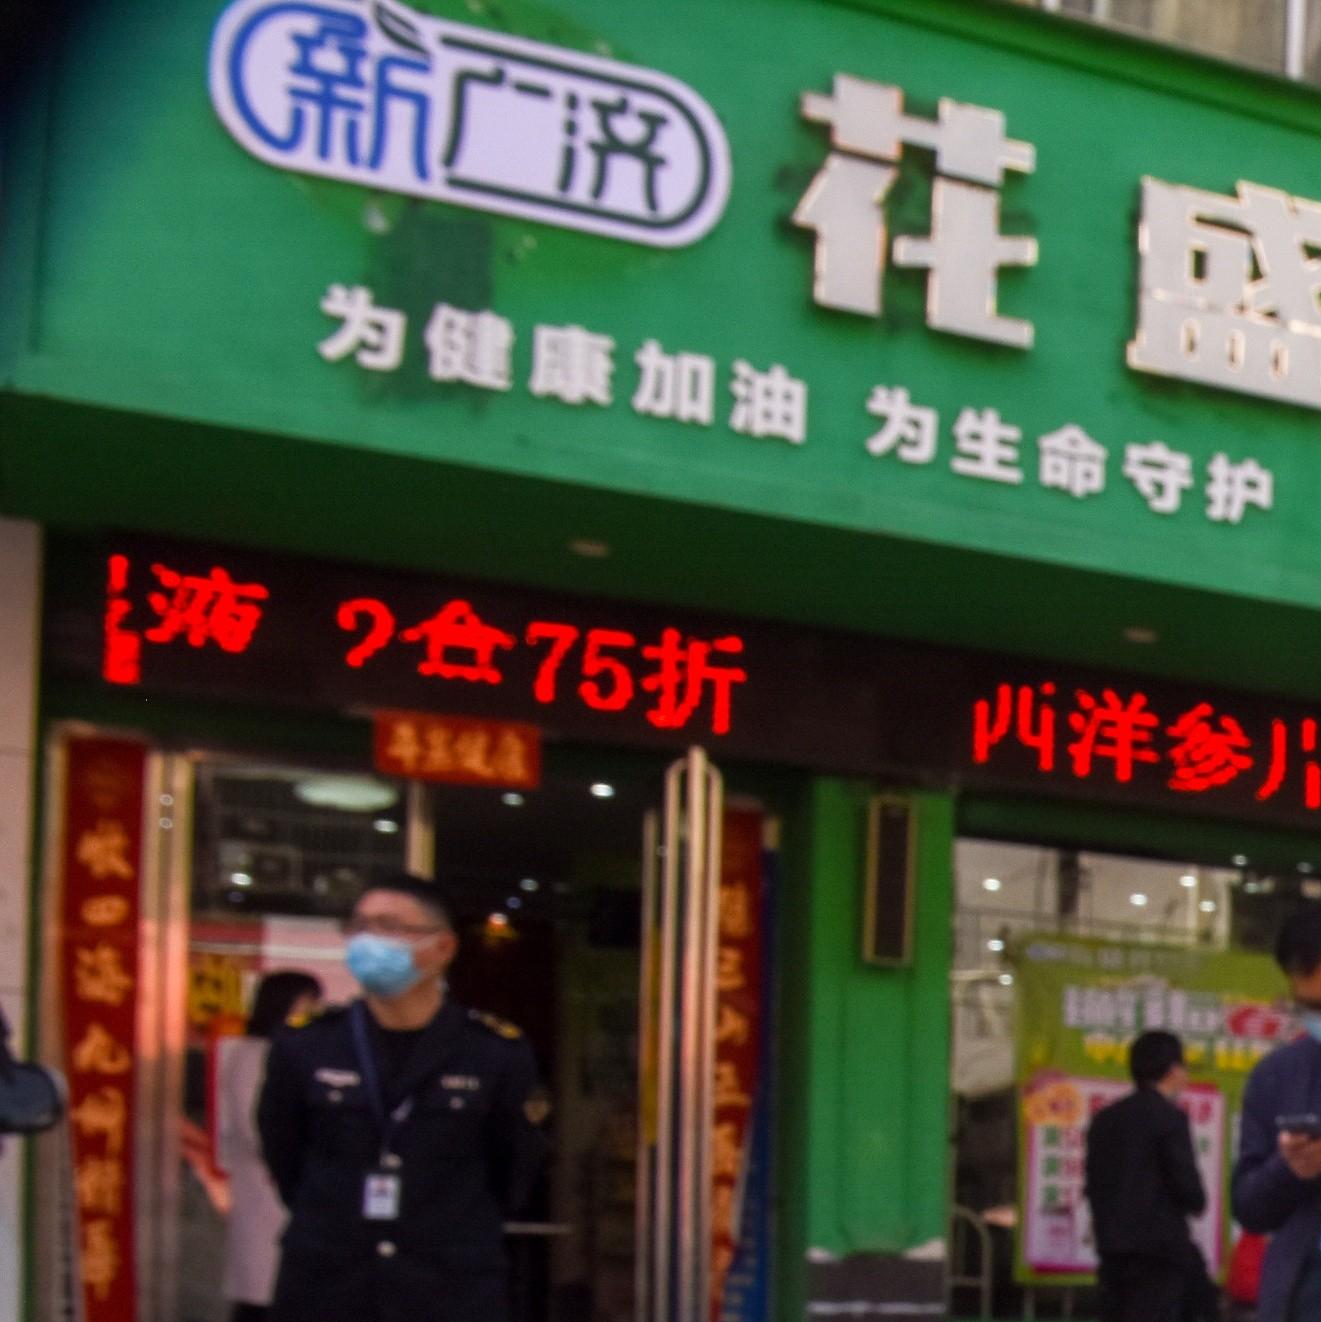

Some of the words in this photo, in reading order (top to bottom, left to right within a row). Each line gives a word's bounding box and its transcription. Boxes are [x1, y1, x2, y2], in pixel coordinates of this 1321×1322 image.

[242, 3, 688, 219] 新广济
[318, 283, 807, 445] 为健康加油
[864, 384, 1275, 525] 为生命守护
